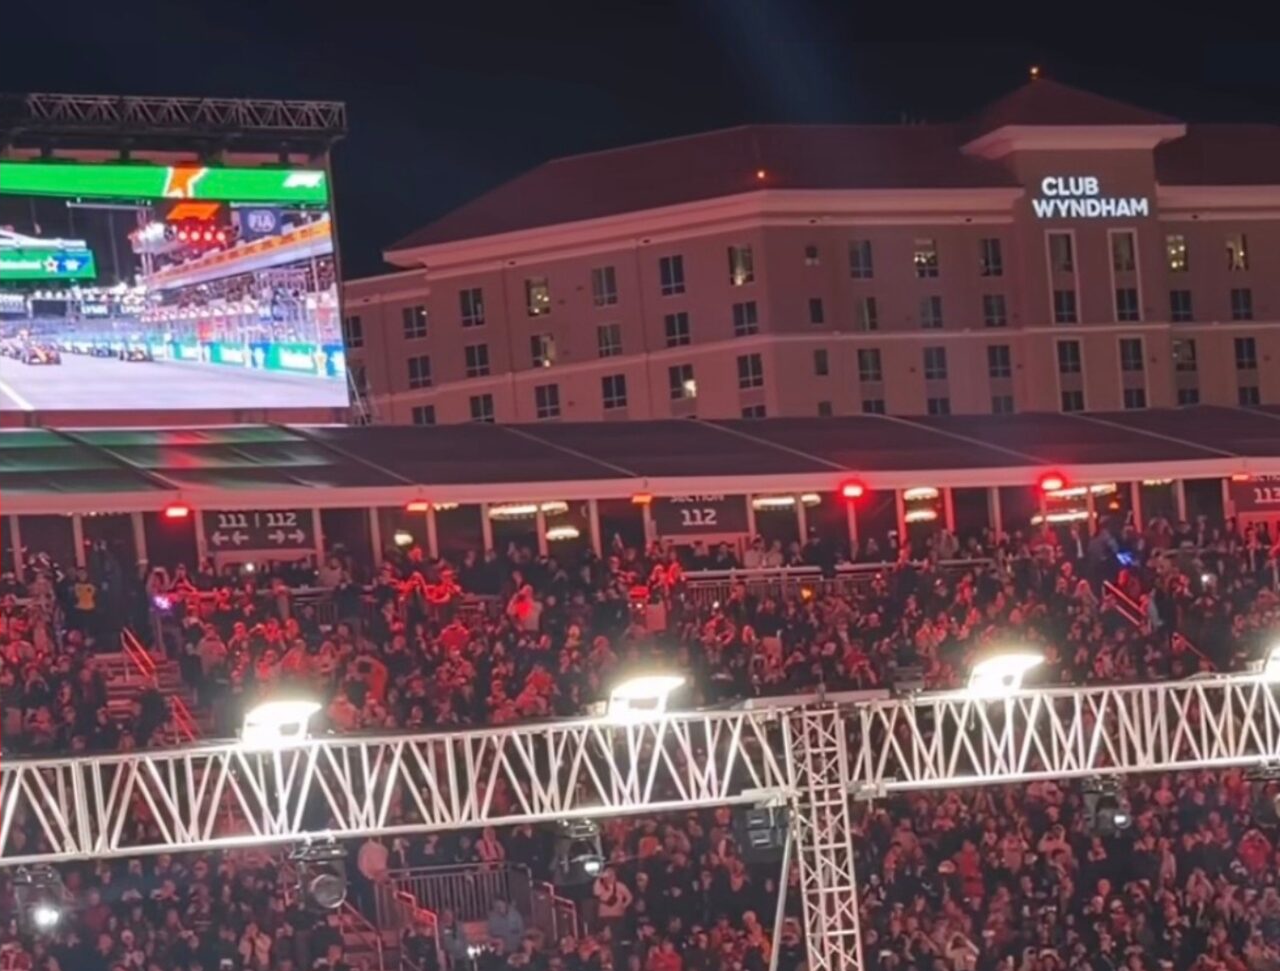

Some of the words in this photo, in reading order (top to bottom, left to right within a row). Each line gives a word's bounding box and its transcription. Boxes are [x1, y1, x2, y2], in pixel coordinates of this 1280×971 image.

[1041, 176, 1099, 196] CLUB
[1032, 198, 1149, 218] WYNDHAM
[218, 512, 249, 528] 111
[266, 512, 297, 527] 112
[681, 508, 717, 526] 112
